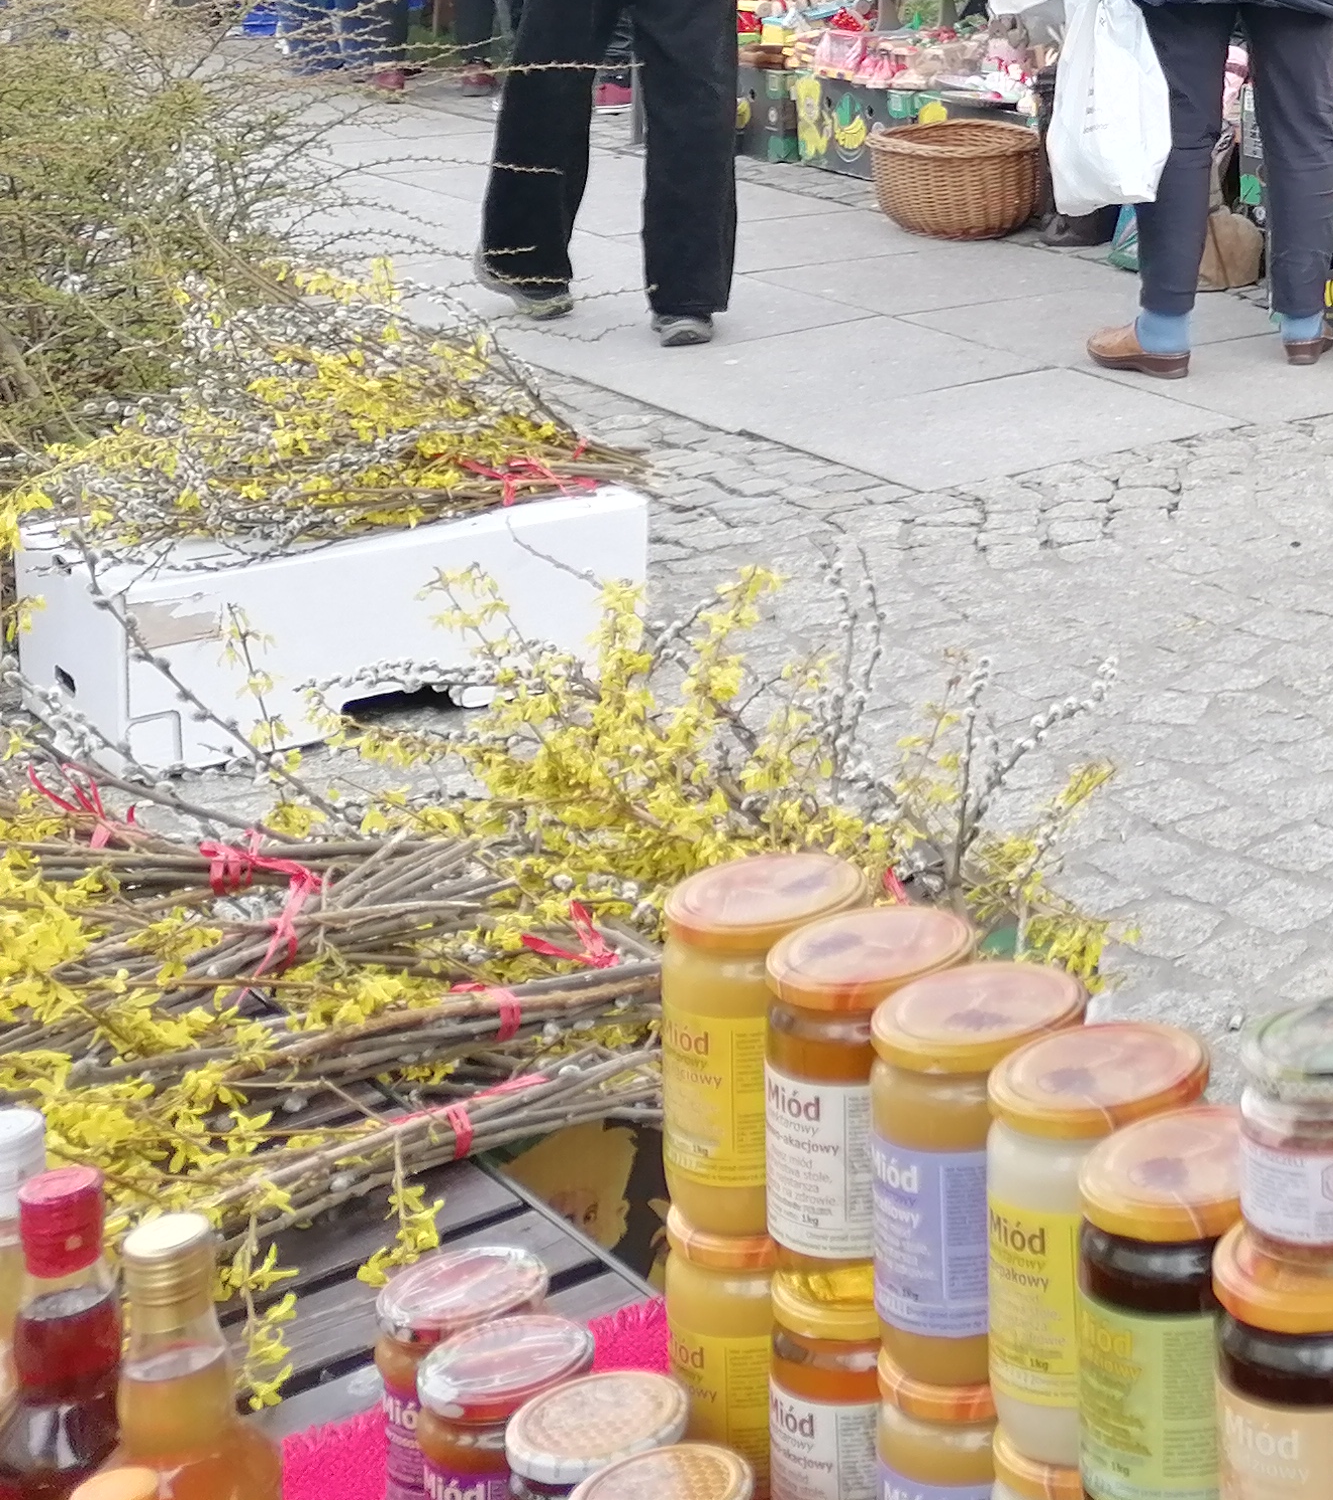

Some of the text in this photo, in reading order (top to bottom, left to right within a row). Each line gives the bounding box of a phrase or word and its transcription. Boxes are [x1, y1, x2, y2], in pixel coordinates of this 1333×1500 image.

[767, 1078, 822, 1123] Miód
[989, 1207, 1046, 1256] Miód
[382, 1389, 419, 1430] Mió
[769, 1393, 815, 1440] Miód
[1224, 1405, 1299, 1461] Miód
